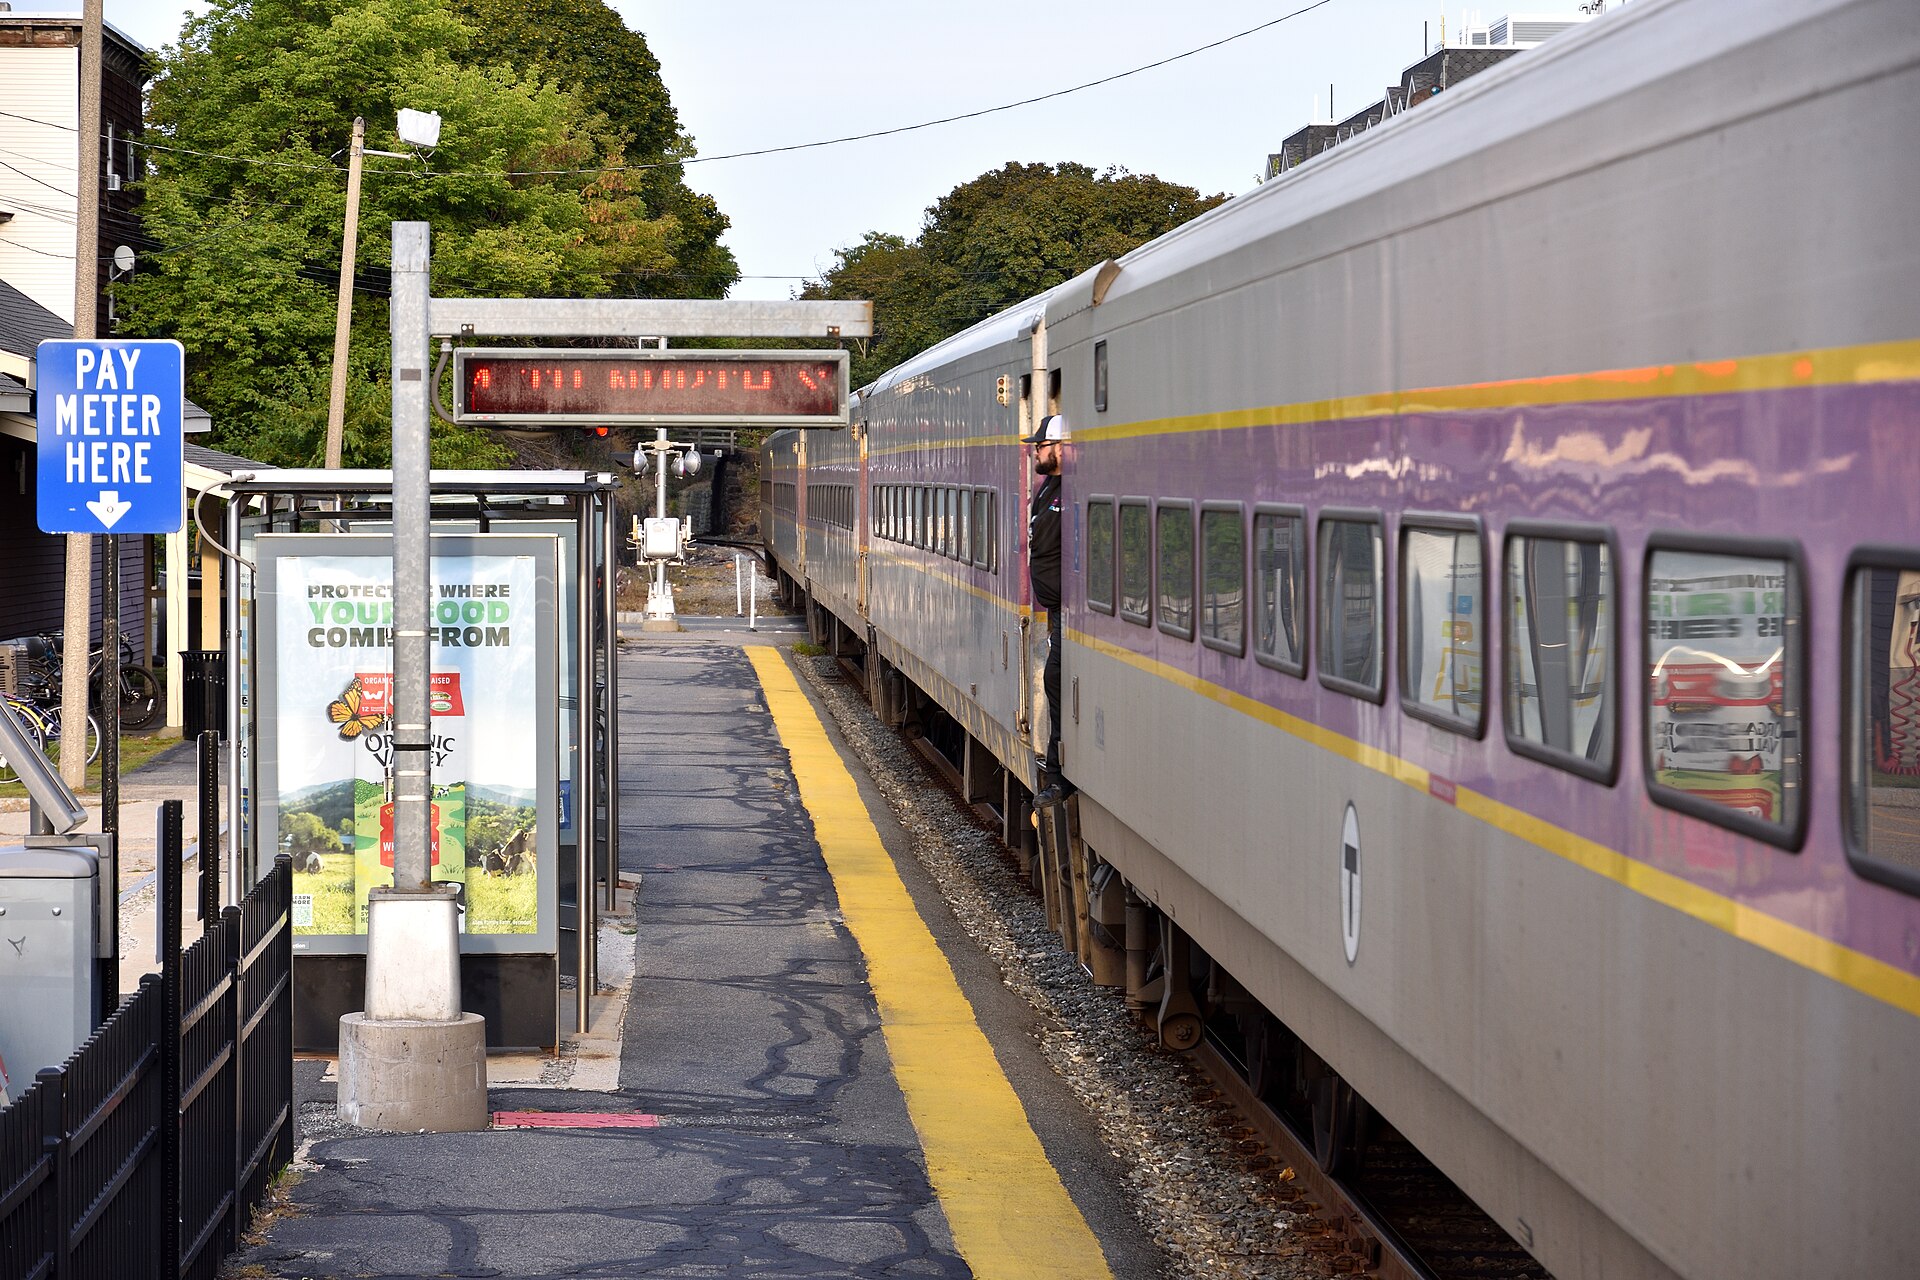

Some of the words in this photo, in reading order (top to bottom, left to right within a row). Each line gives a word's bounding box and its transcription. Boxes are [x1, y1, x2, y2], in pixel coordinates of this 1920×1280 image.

[76, 348, 141, 390] PAY
[55, 394, 161, 436] METER
[66, 441, 152, 483] HERE
[439, 584, 510, 598] WHERE
